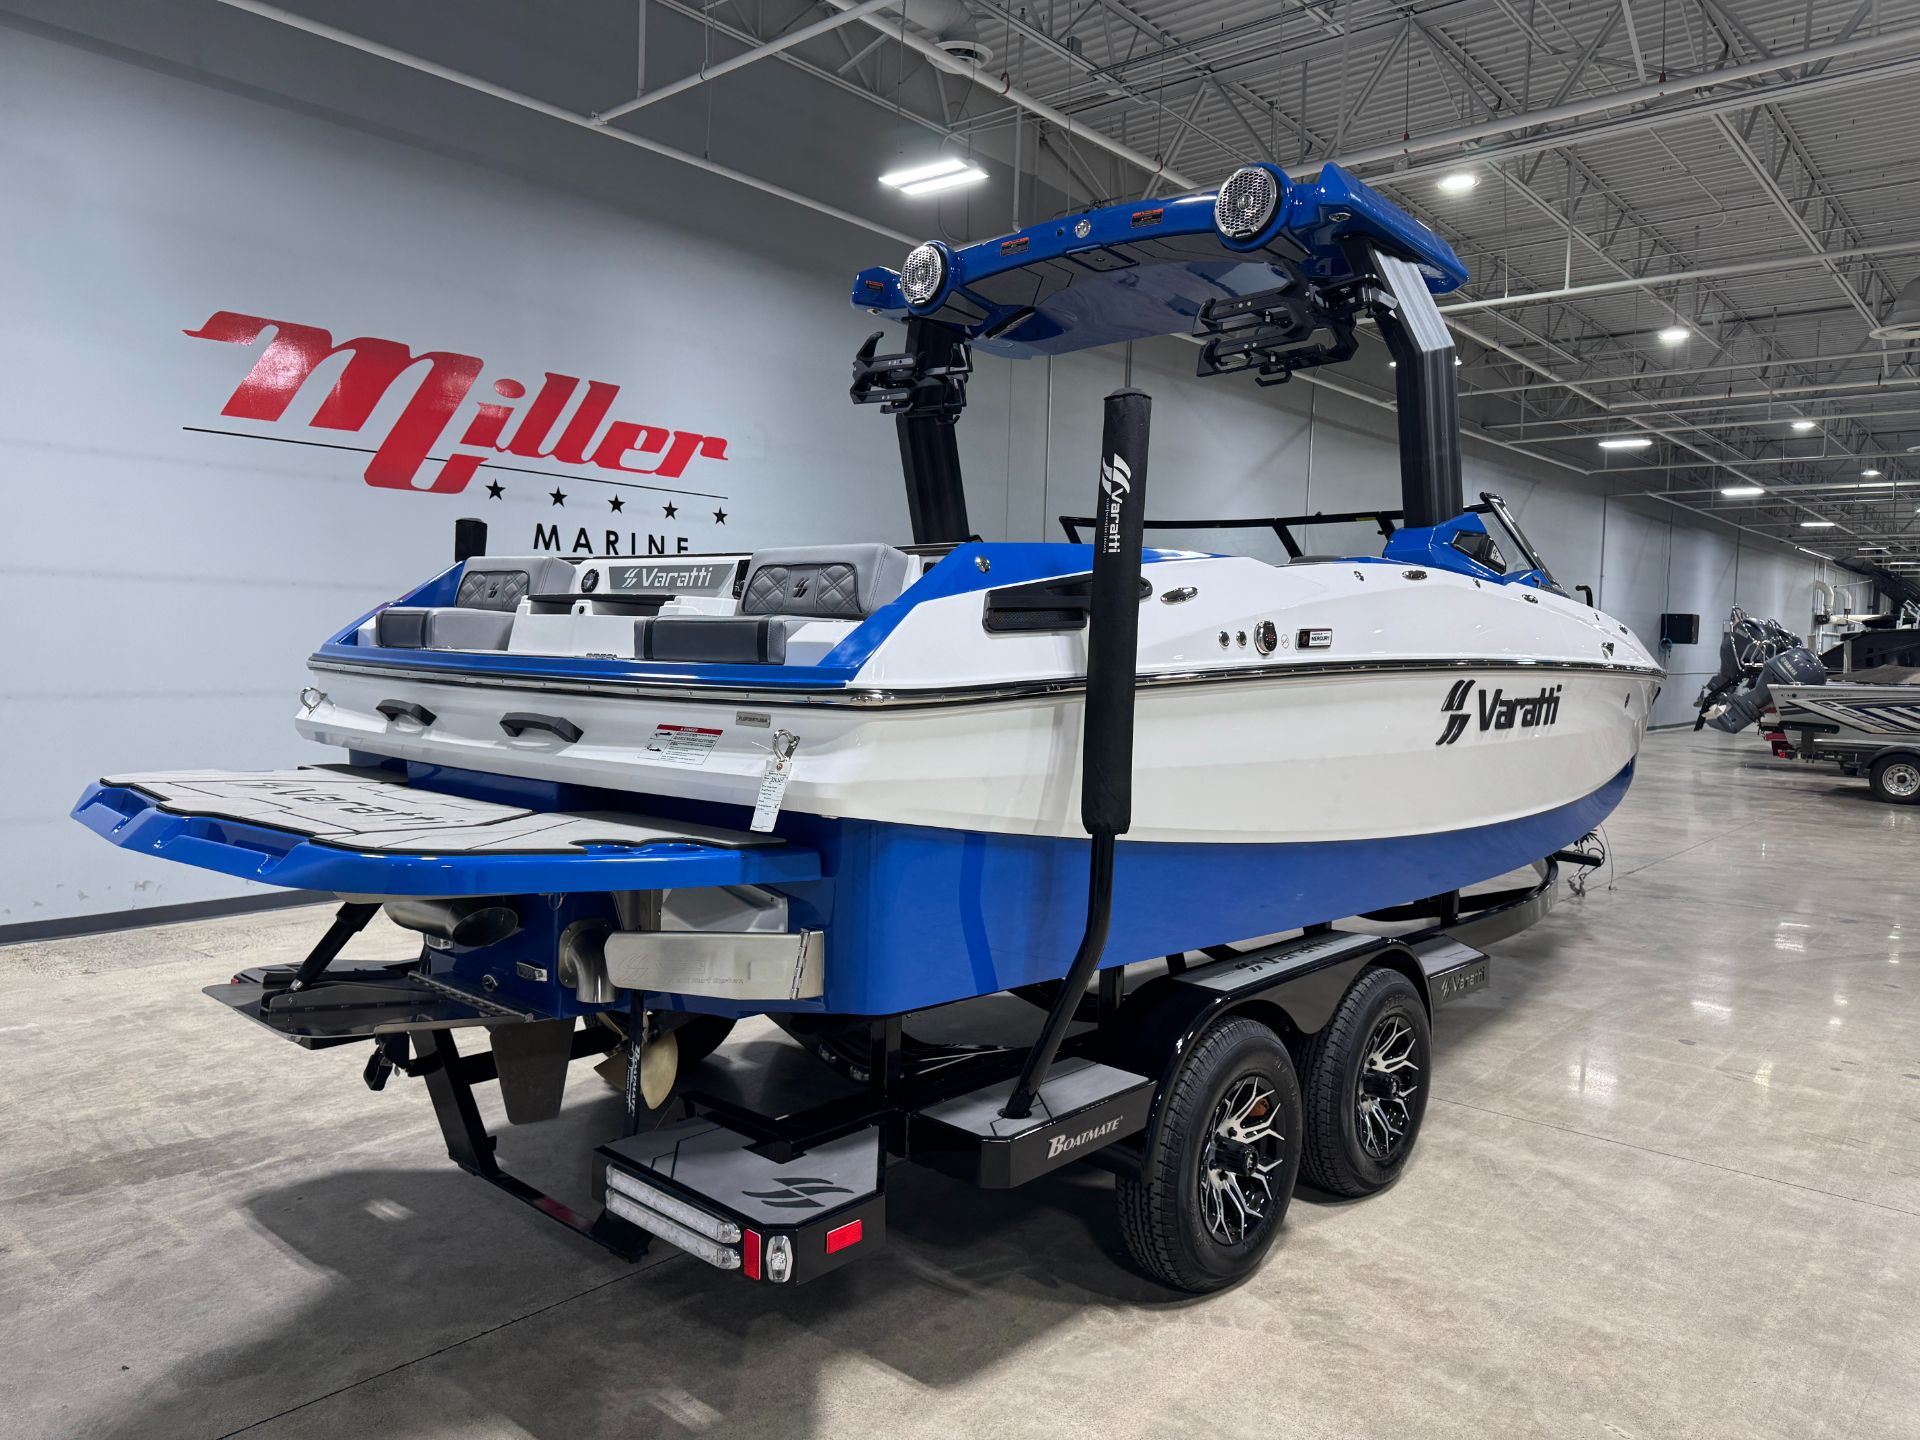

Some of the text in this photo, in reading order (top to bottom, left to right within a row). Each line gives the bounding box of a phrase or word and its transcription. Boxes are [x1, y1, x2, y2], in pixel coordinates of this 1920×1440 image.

[182, 310, 729, 494] Miller
[1108, 488, 1124, 553] Varatti
[533, 522, 689, 556] MARINE
[642, 567, 713, 587] Varatti
[1477, 684, 1562, 732] Varatti
[271, 788, 465, 826] Varatti
[1250, 941, 1334, 964] Varatti
[1452, 966, 1486, 992] Varatti
